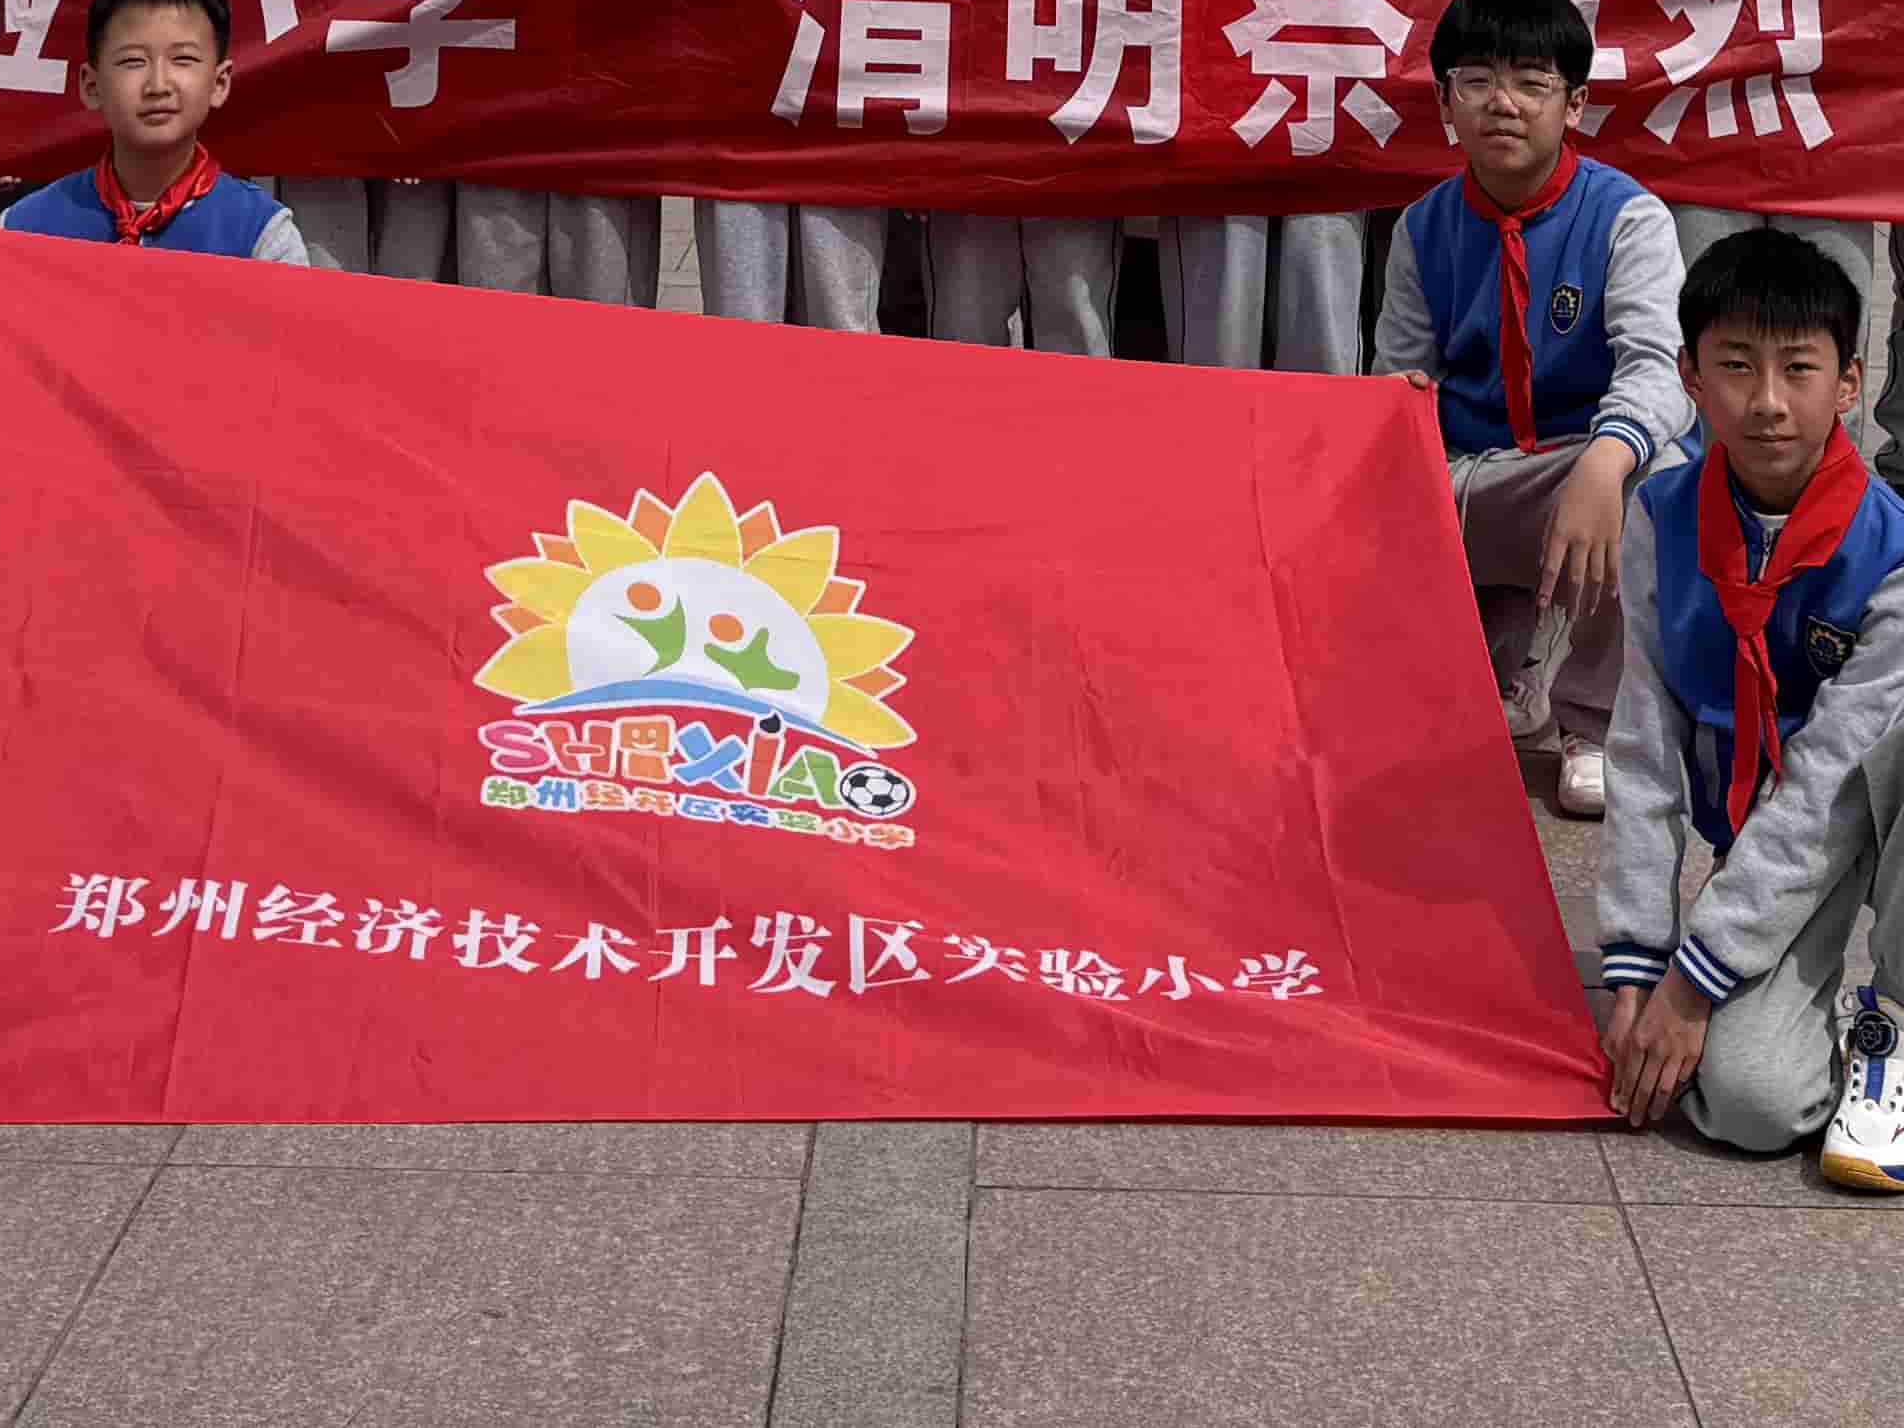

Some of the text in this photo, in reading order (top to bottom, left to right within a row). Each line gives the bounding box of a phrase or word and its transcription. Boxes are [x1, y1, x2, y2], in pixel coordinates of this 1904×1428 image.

[52, 871, 1323, 1001] 郑州经济技术开发区实验小学
